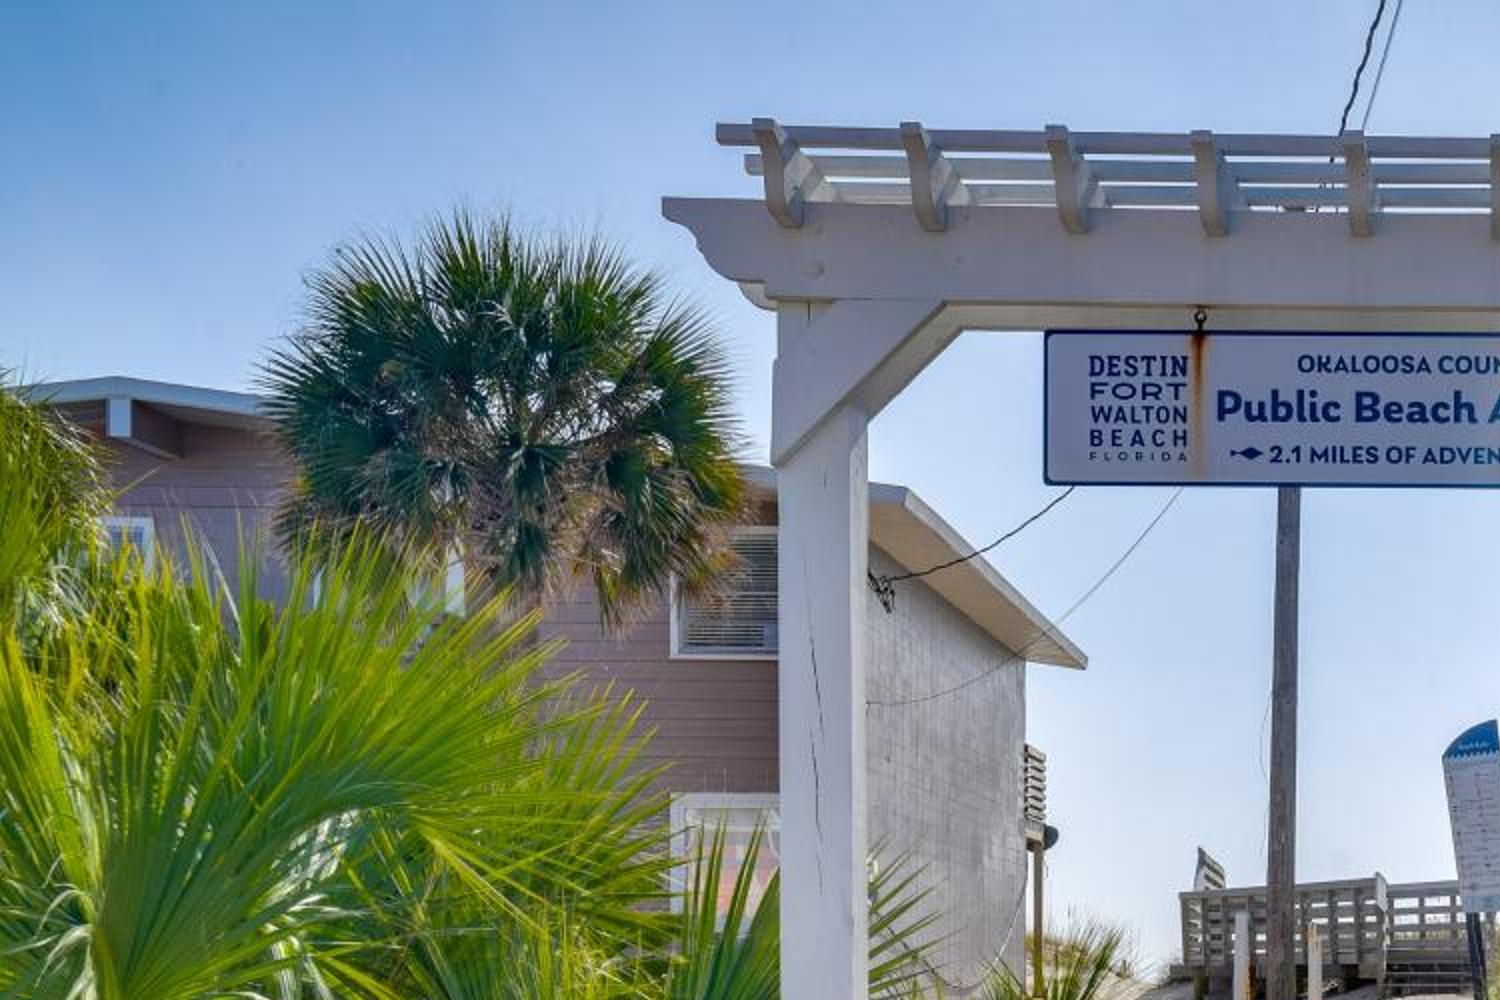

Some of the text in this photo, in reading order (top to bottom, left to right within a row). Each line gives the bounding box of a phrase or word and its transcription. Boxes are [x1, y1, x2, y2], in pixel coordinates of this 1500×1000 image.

[1089, 355, 1188, 377] DESTIN
[1297, 355, 1432, 374] OKALOOSA
[1089, 382, 1188, 401] FORT
[1091, 405, 1188, 425] WALTON
[1216, 388, 1341, 423] Public
[1354, 390, 1478, 424] Beach
[1090, 429, 1188, 447] BEACH
[1089, 451, 1188, 461] FLORIDA
[1269, 446, 1301, 464] 2.1
[1310, 446, 1379, 465] MILES
[1386, 447, 1417, 465] OF
